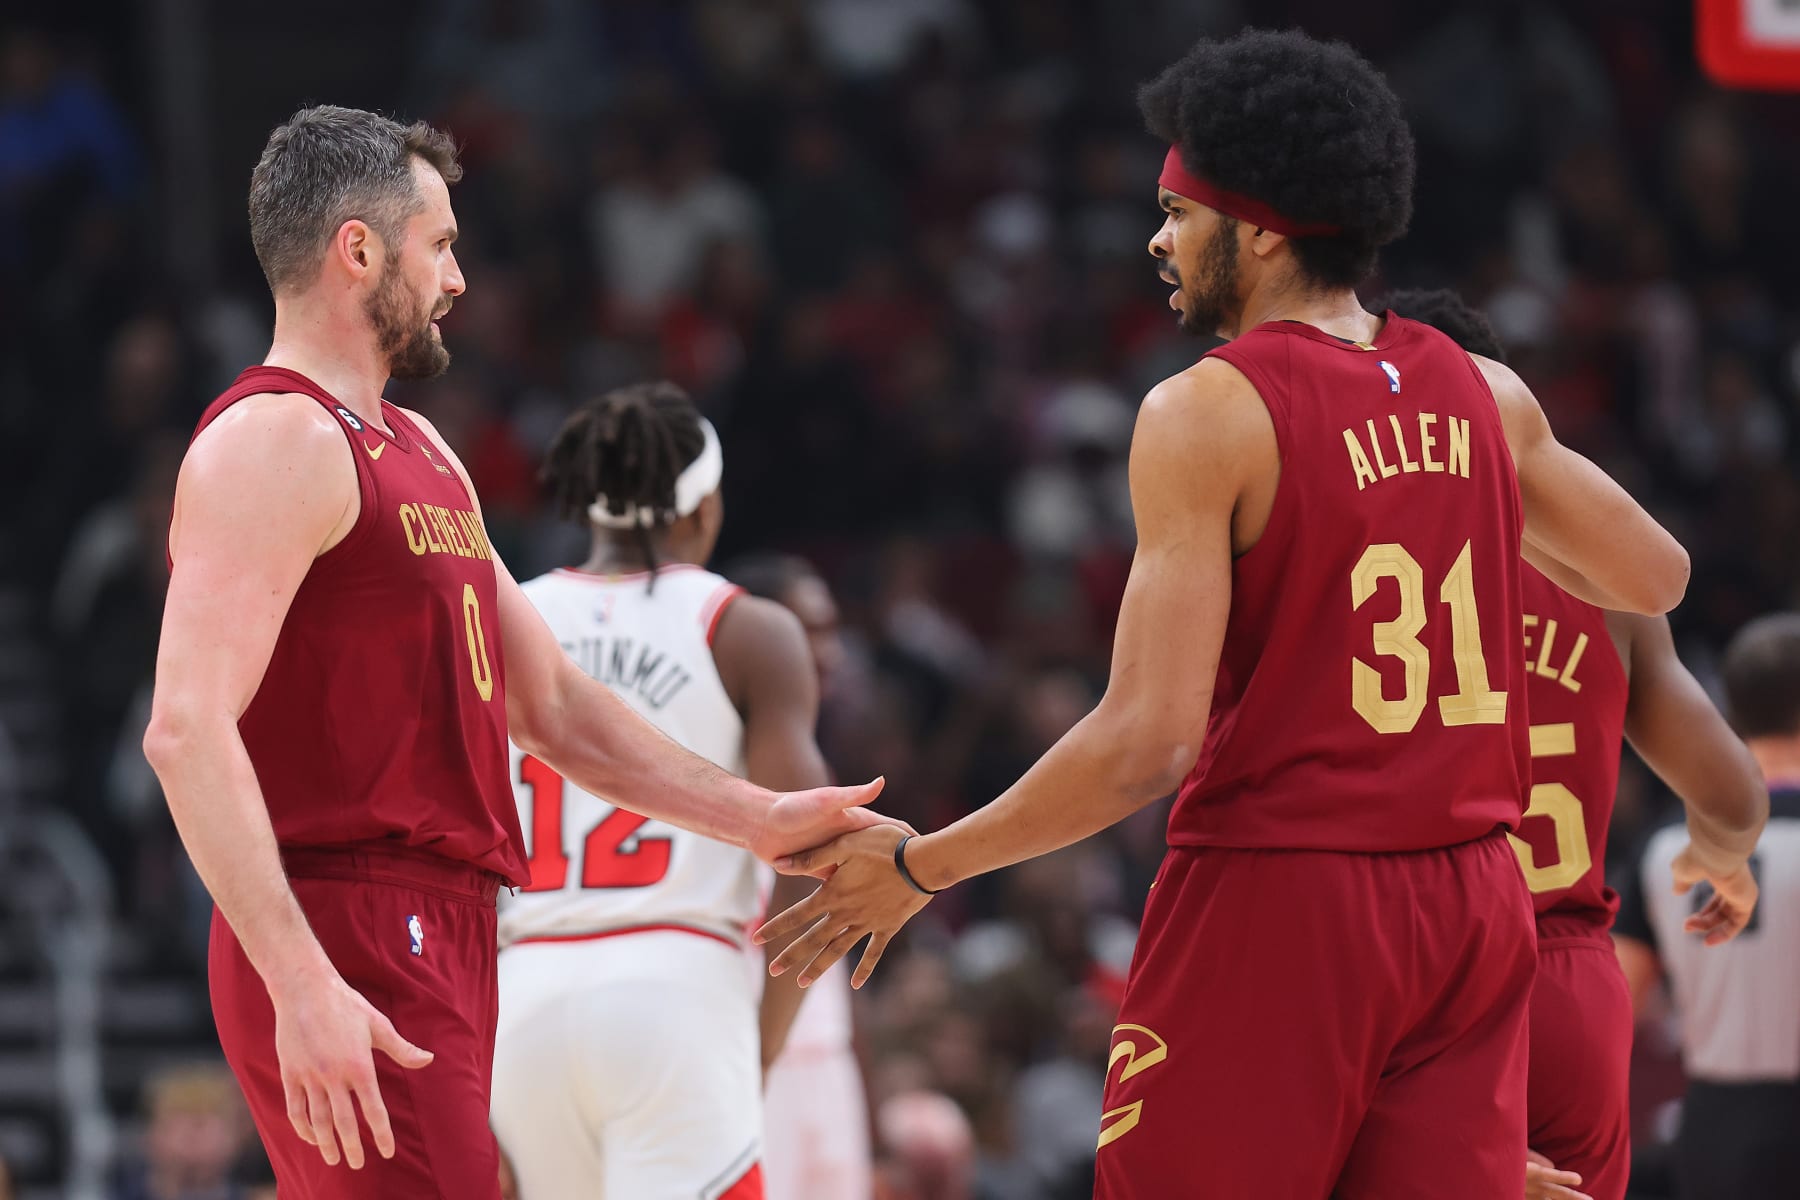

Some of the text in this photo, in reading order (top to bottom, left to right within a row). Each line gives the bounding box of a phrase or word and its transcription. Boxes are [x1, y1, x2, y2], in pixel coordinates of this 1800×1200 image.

[336, 408, 362, 430] 6
[1342, 412, 1470, 491] ALLEN
[399, 503, 492, 561] CLEVELAN
[463, 583, 493, 702] 0
[559, 635, 693, 711] UNMU
[1350, 538, 1508, 734] 31
[520, 752, 673, 893] 12
